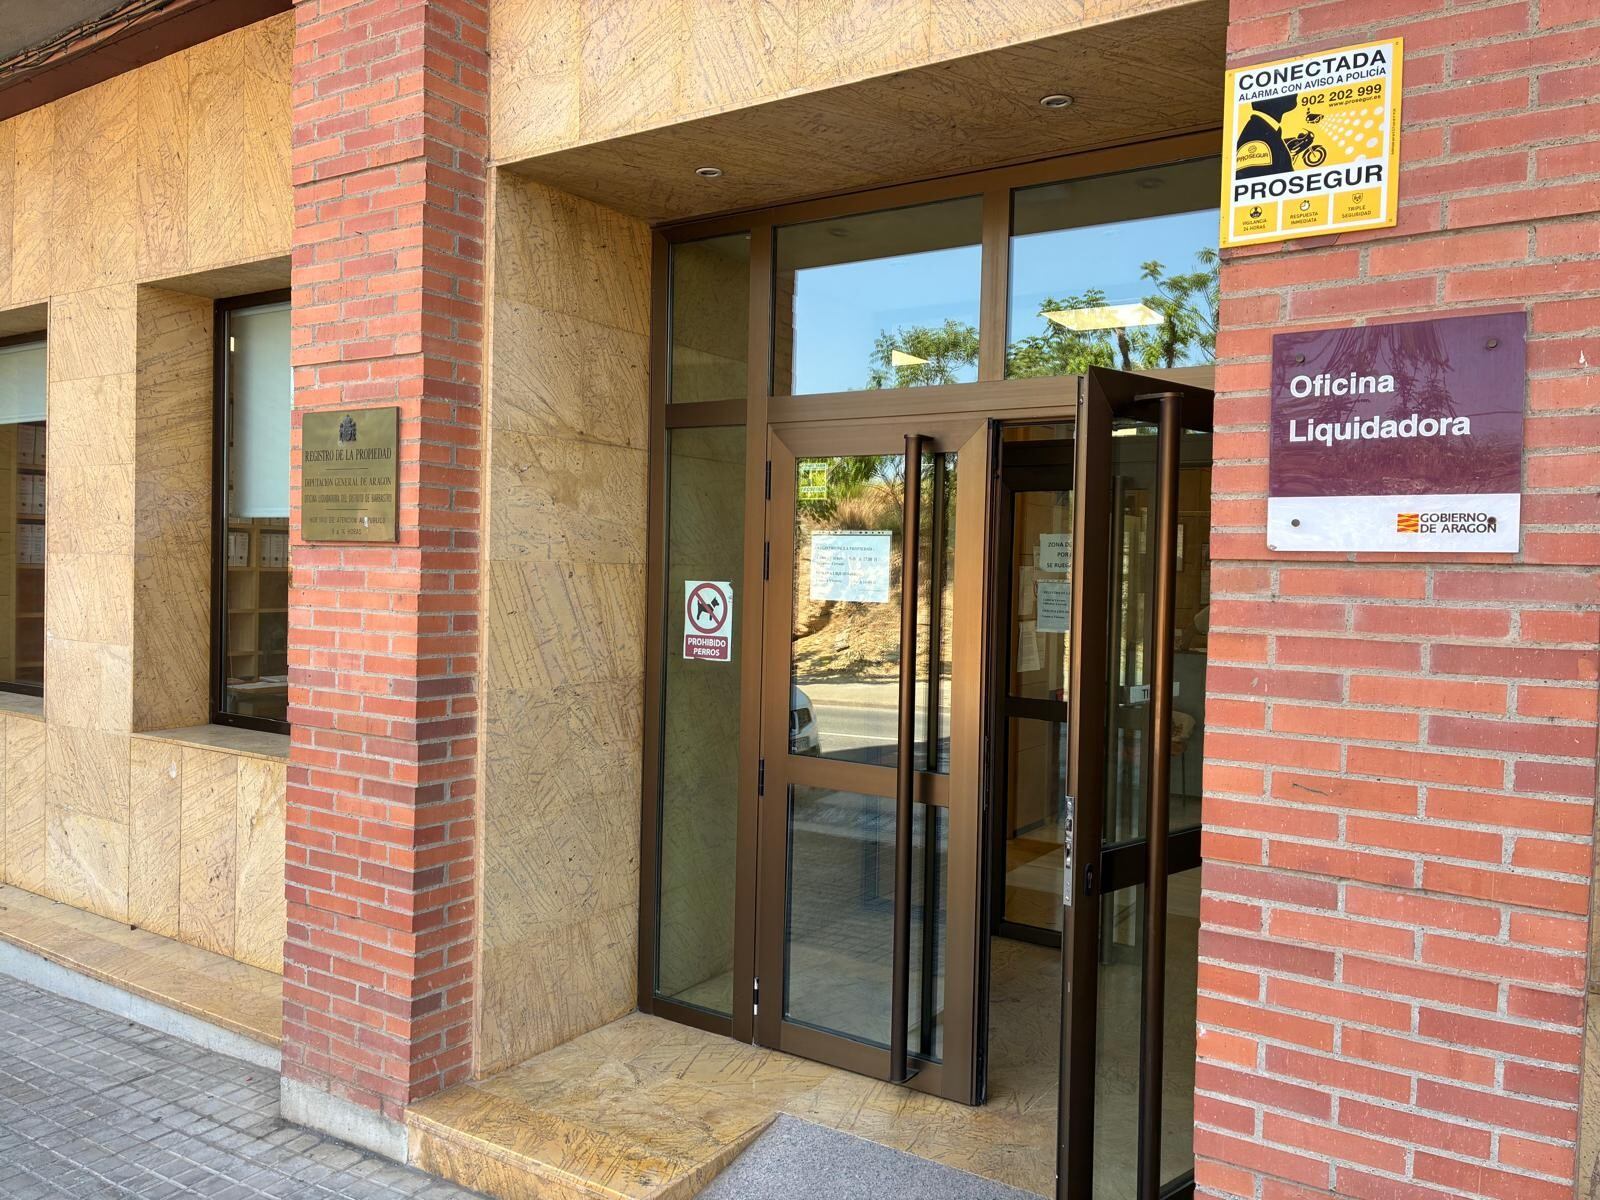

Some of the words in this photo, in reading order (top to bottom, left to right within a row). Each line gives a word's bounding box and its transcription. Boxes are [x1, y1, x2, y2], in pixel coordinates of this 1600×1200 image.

[1238, 49, 1387, 91] CONECTADA
[1239, 88, 1279, 102] ALARMA
[1281, 83, 1302, 94] CON
[1304, 76, 1334, 90] AVISO
[1336, 74, 1344, 84] A
[1346, 66, 1386, 81] POLICÍA
[1301, 93, 1325, 107] 902
[1328, 88, 1353, 102] 202
[1357, 83, 1382, 97] 999
[1328, 94, 1382, 108] www.prosegur.es
[1234, 164, 1382, 202] PROSEGUR
[1290, 211, 1319, 220] RESPUESTA
[1290, 217, 1317, 225] INMEDIATA
[1341, 210, 1372, 219] SEGURIDAD
[1289, 372, 1395, 399] Oficina
[1288, 413, 1471, 447] Liquidadora
[305, 449, 334, 462] REGISTRO
[335, 449, 343, 461] DE
[345, 448, 354, 461] LA
[355, 447, 392, 460] PROPIEDAD
[1420, 512, 1488, 523] GOBIERNO
[1420, 523, 1437, 533] DE
[1441, 523, 1497, 533] ARAGON
[687, 637, 727, 648] PROHIBIDO
[692, 647, 720, 657] PERROS
